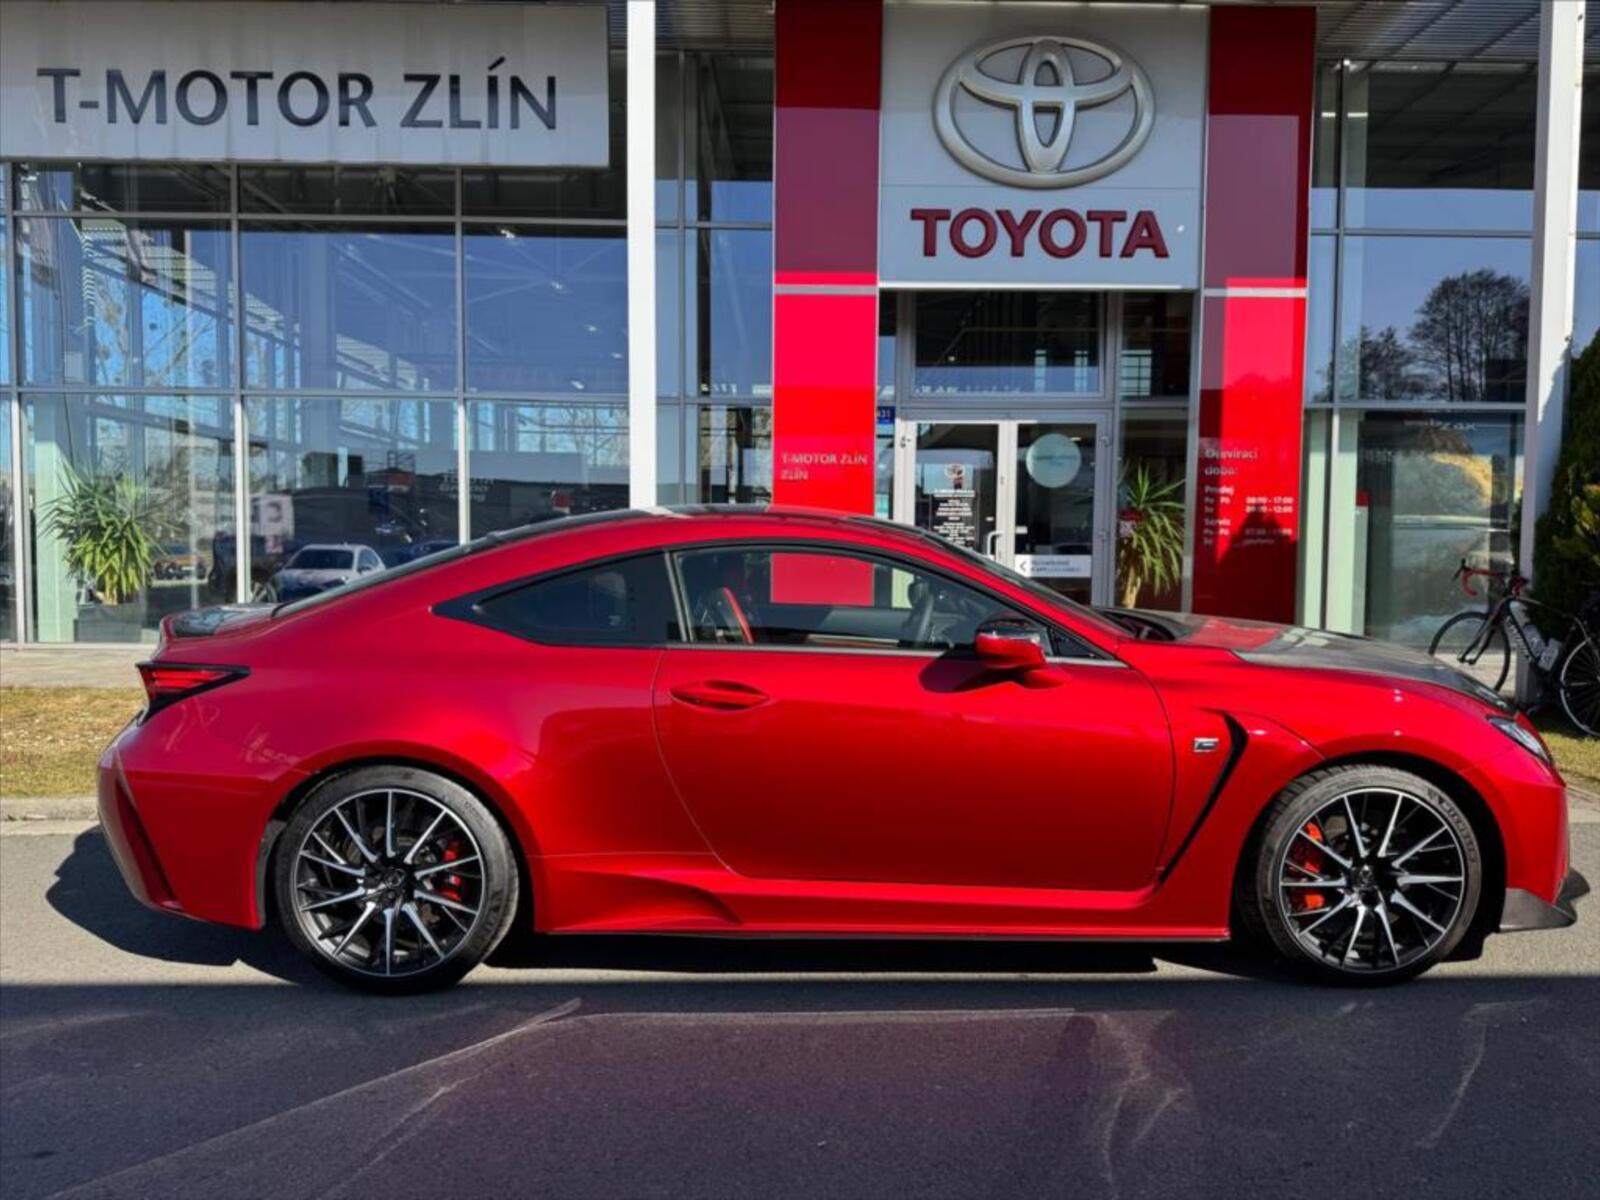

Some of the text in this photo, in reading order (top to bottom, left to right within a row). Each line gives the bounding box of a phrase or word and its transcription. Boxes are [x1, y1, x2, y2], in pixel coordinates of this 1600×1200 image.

[36, 55, 557, 131] T-MOTOR ZLÍN
[910, 208, 1170, 259] TOYOTA
[781, 452, 868, 464] T-MOTOR ZLÍN
[781, 468, 808, 480] ZLÍN
